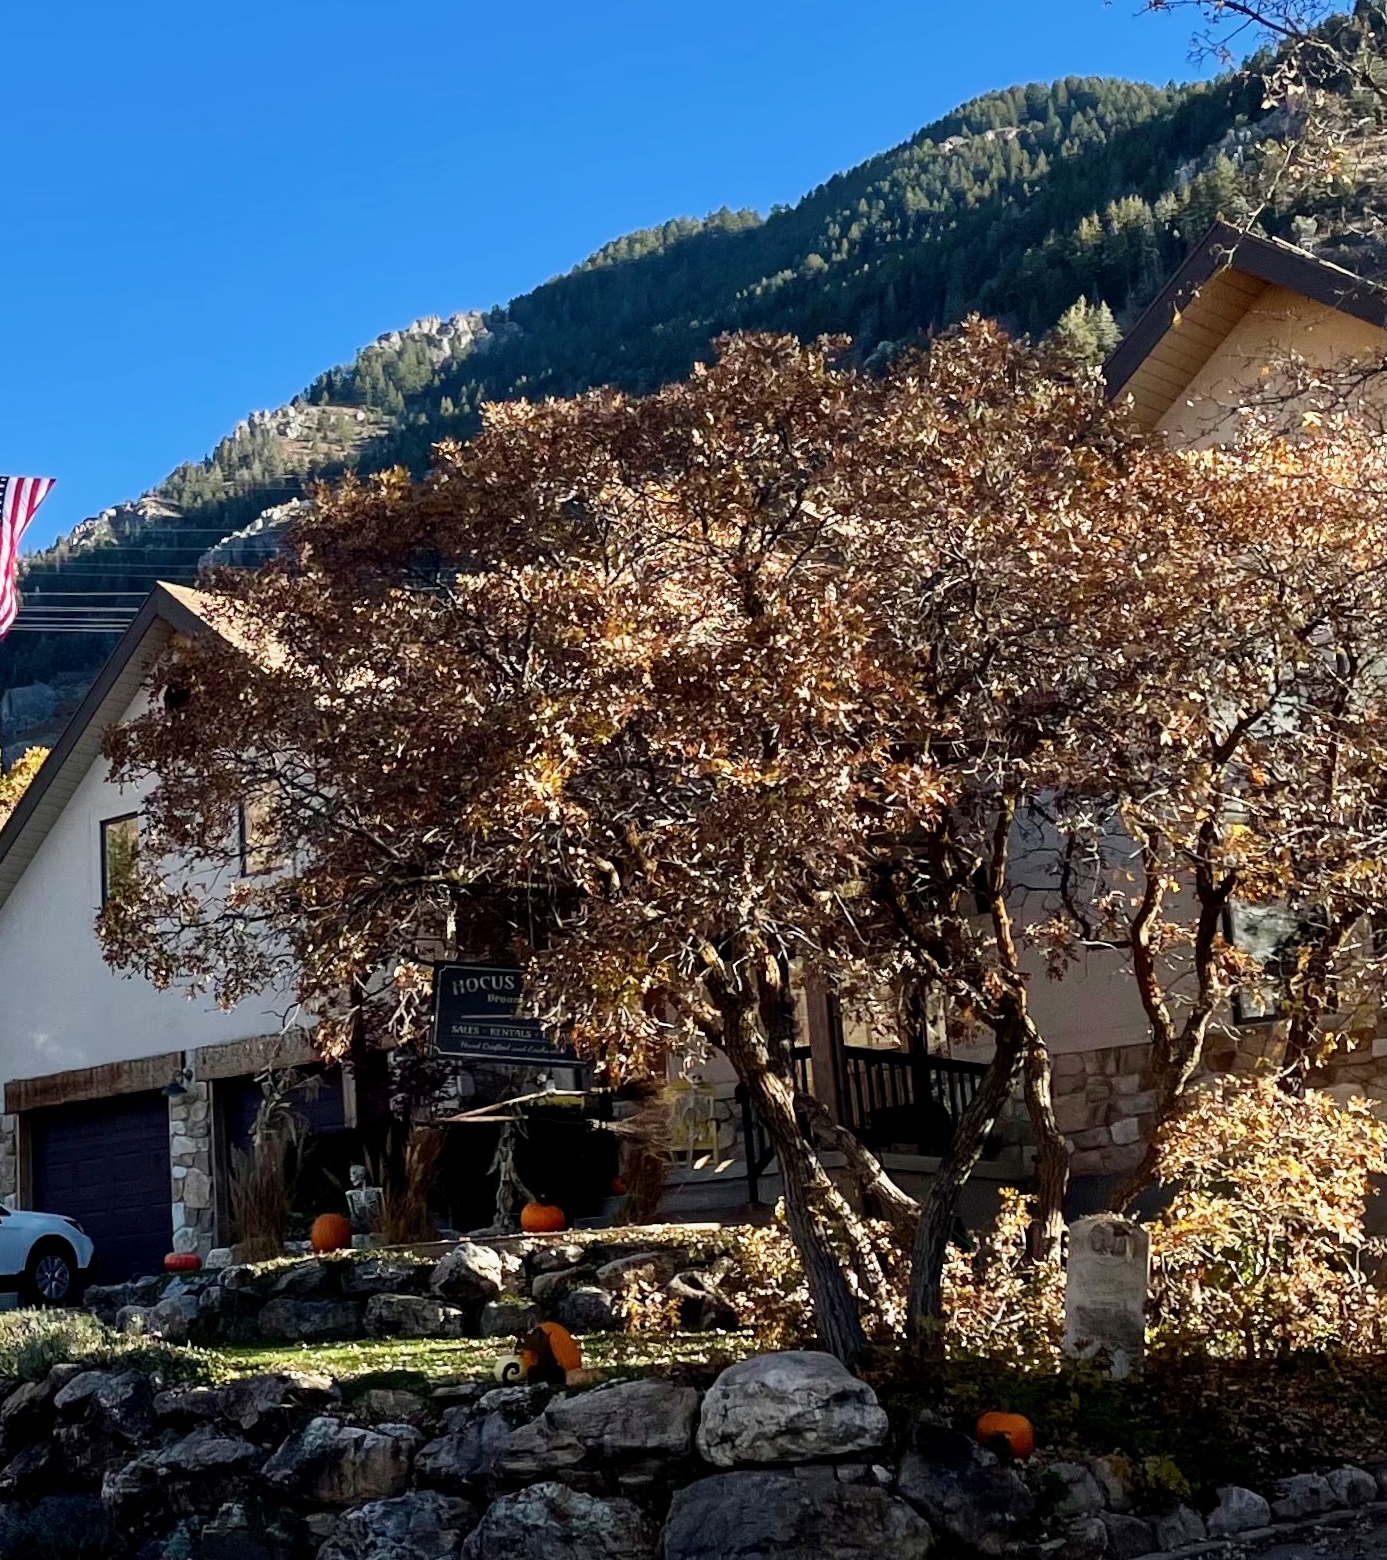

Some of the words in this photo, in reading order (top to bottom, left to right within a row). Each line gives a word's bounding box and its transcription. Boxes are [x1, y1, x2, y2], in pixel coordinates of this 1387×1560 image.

[452, 975, 515, 996] HOCUS
[451, 1025, 480, 1035] SALES
[490, 1027, 532, 1039] RENTALS
